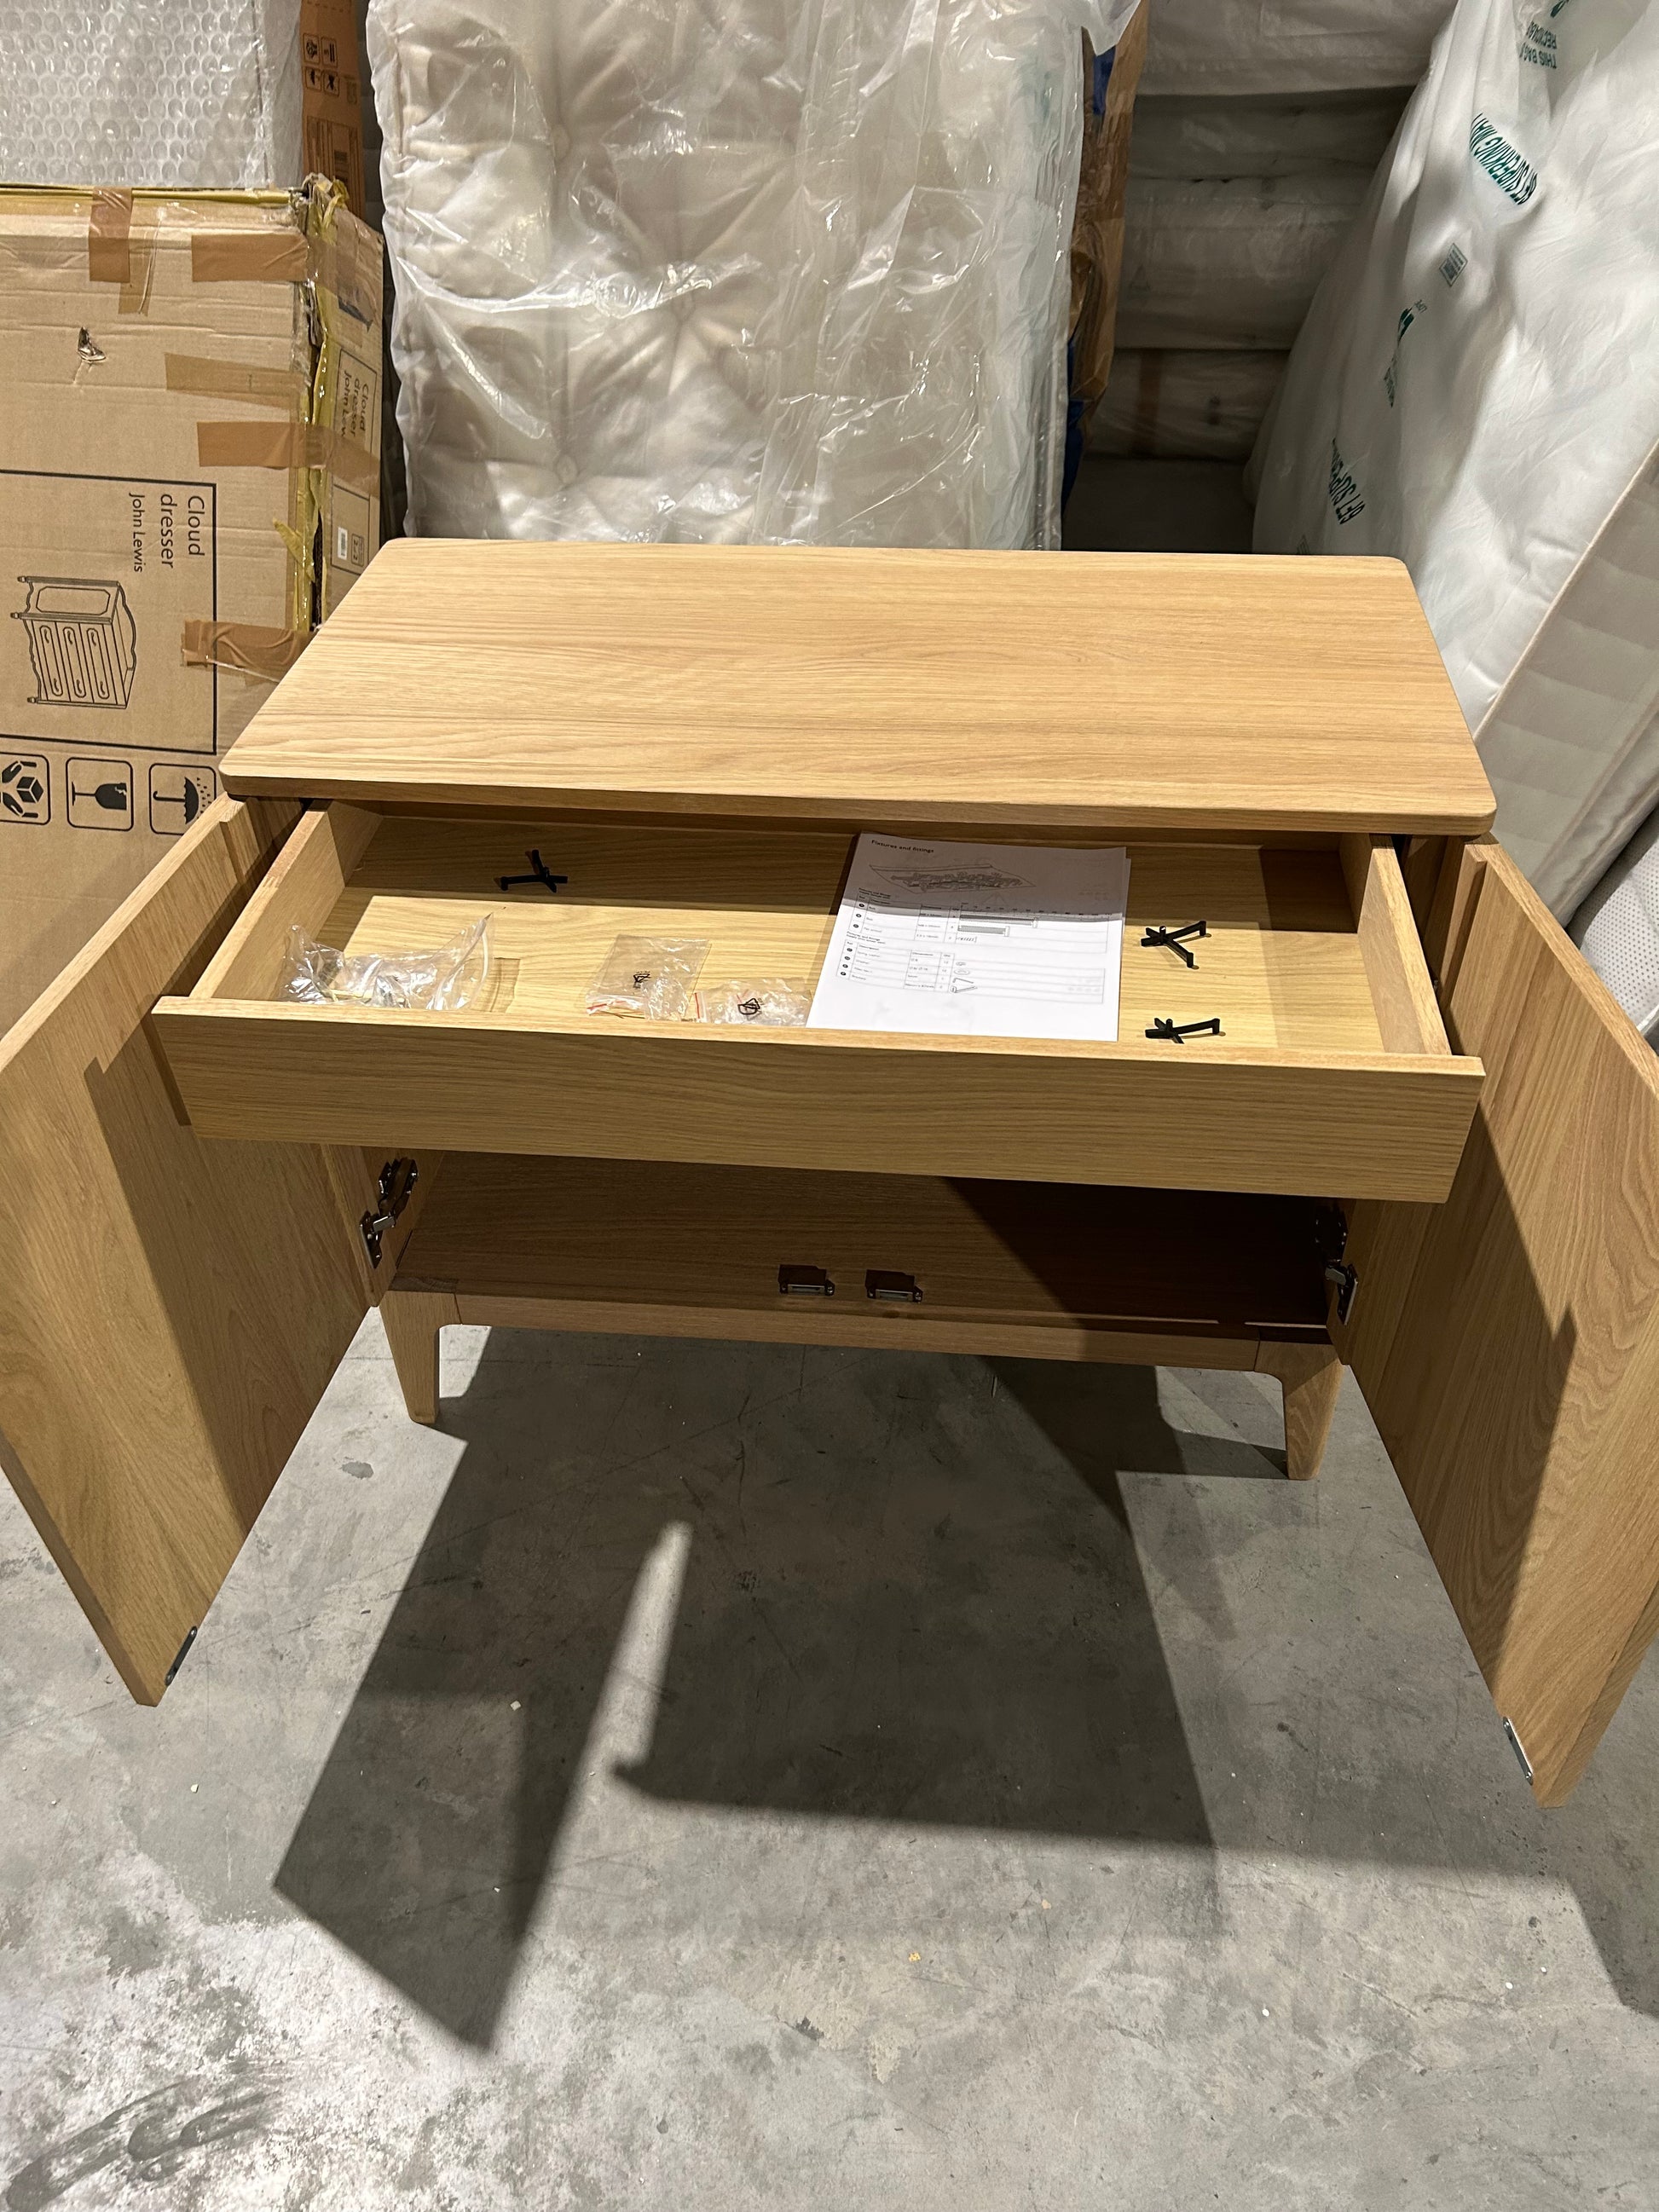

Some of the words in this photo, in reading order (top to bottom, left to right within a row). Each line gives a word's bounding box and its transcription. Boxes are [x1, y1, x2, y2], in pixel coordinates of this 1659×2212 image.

[1538, 50, 1558, 69] THIS
[1473, 136, 1530, 193] SUPERKING
[343, 370, 352, 406] John
[350, 378, 361, 437] dresser
[359, 383, 370, 431] Cloud
[128, 491, 146, 529] John
[159, 493, 178, 569] dresser
[187, 494, 205, 556] Cloud
[132, 532, 146, 573] Lewis
[870, 839, 898, 850] Fixtures
